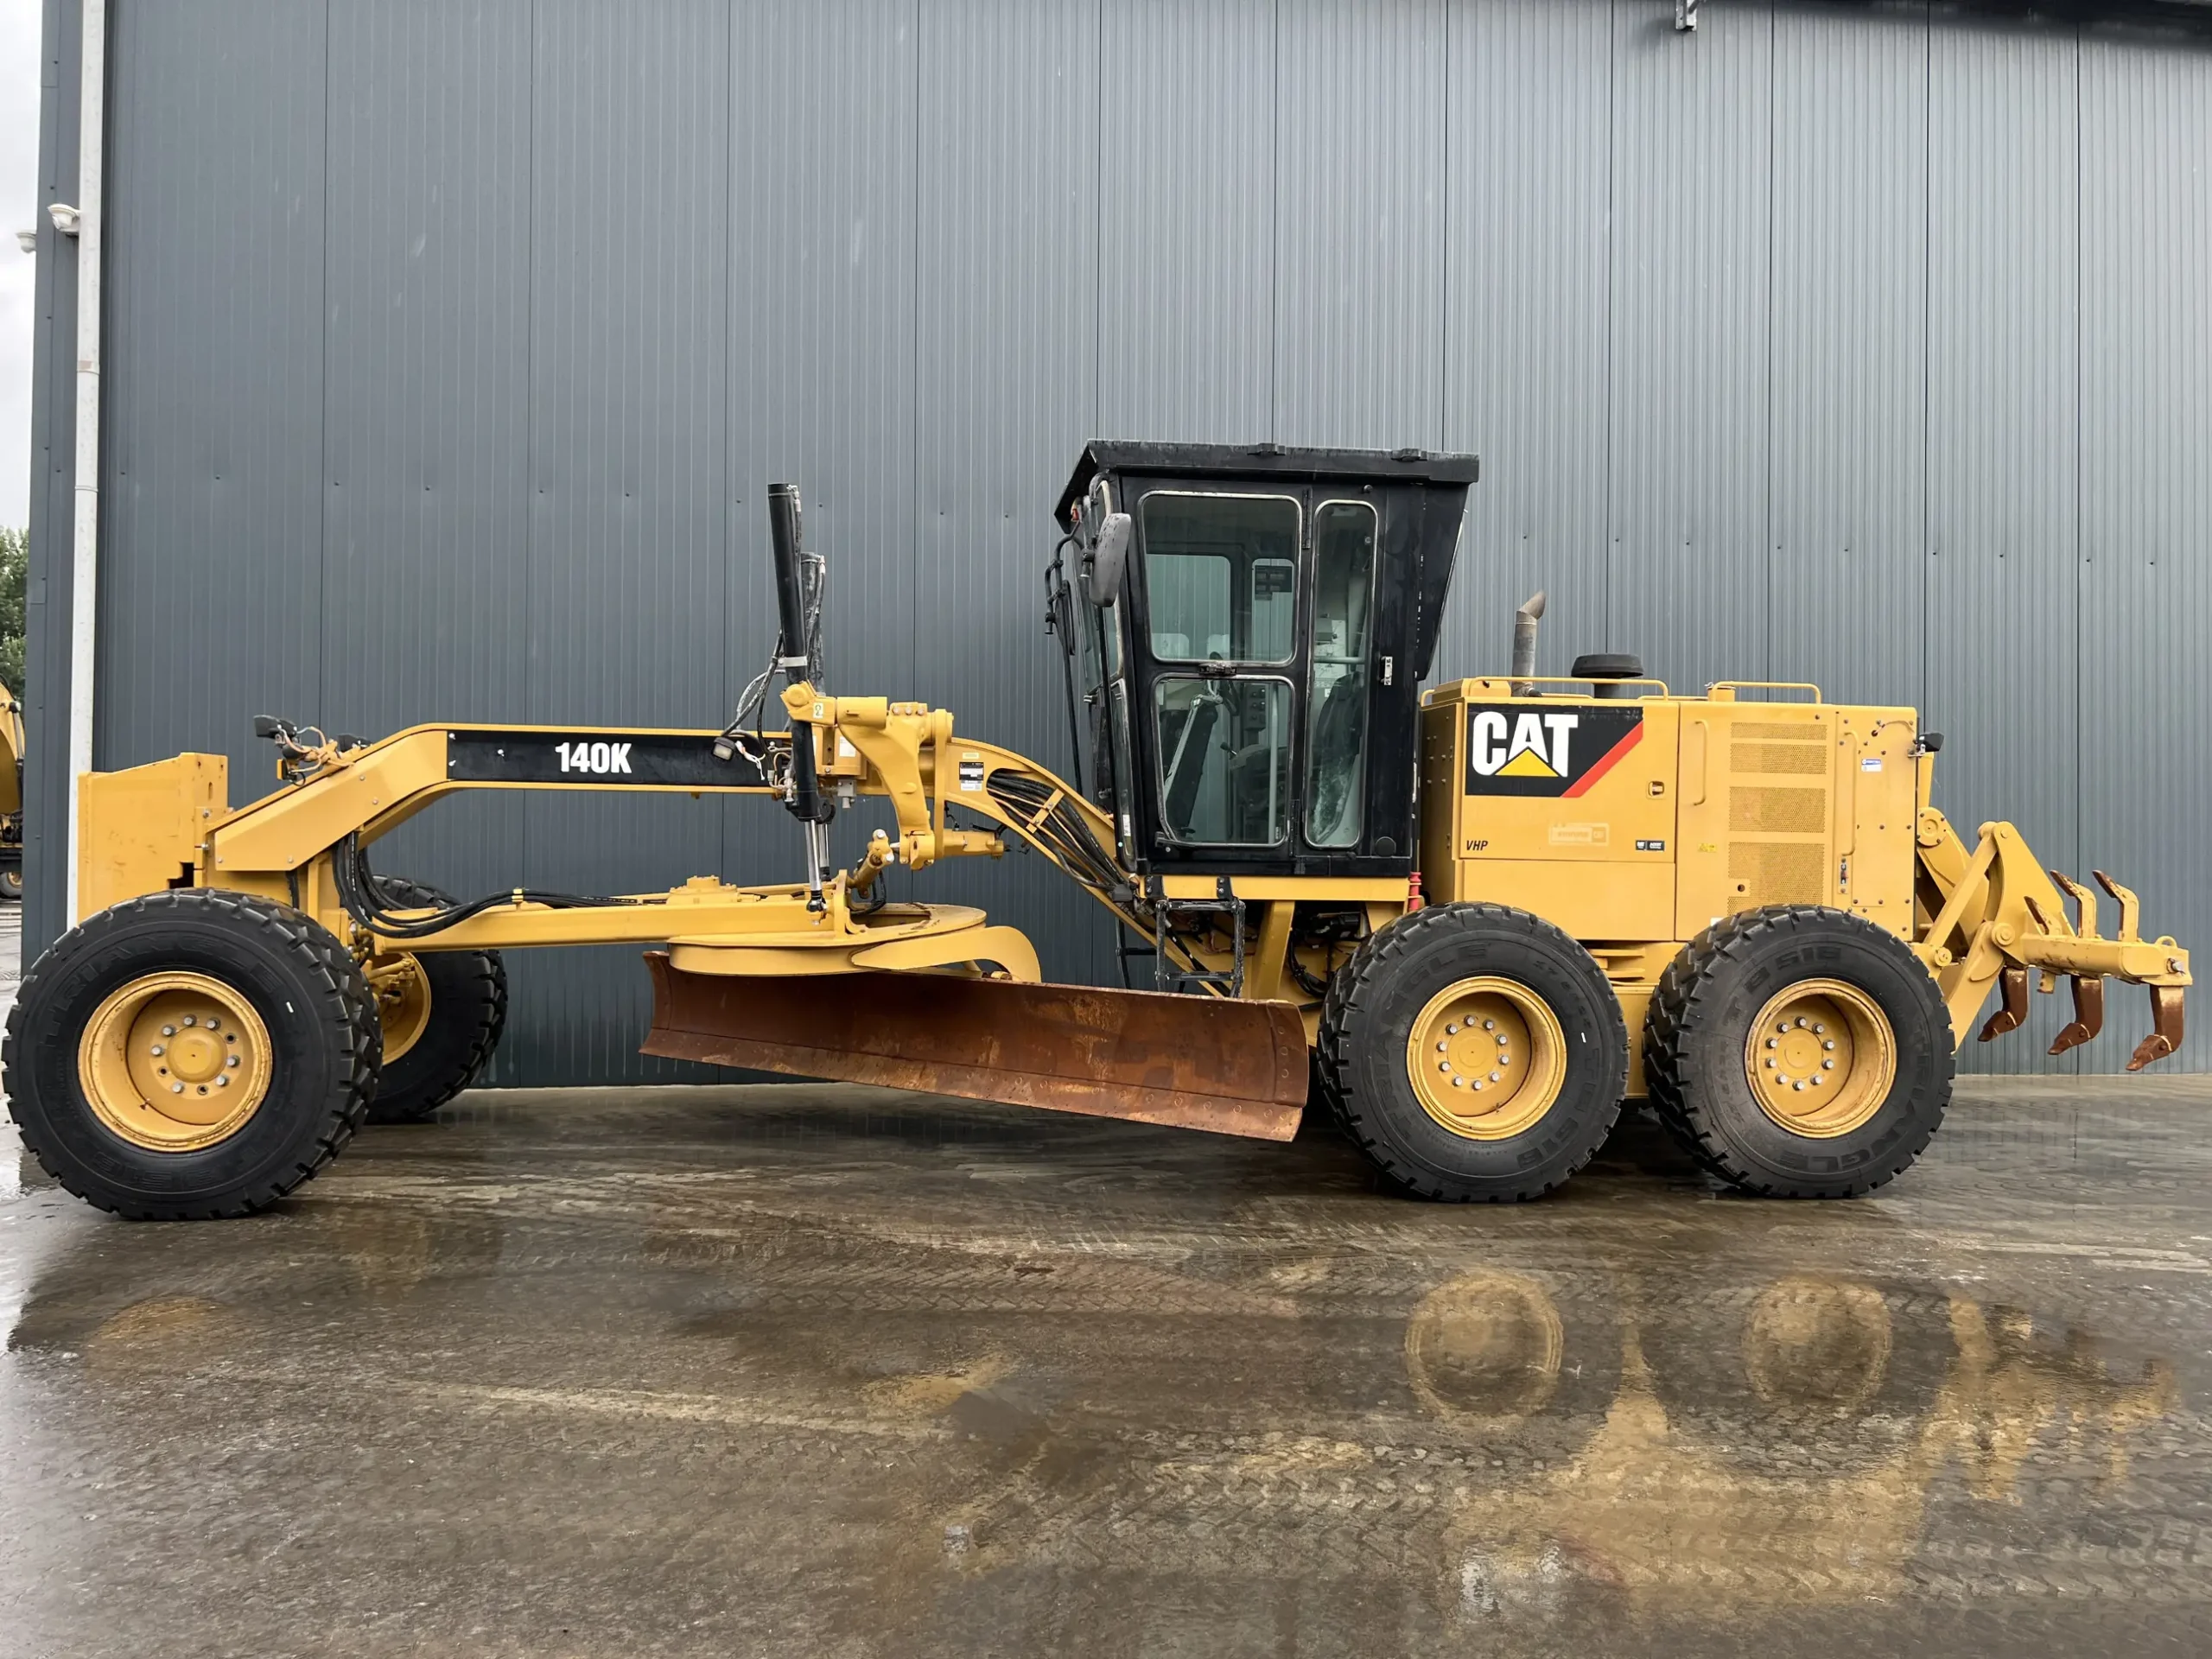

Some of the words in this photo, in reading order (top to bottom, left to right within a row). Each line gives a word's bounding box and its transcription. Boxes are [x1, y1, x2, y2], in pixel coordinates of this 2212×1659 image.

[555, 742, 632, 773] 140K
[1472, 711, 1579, 777] CAT
[1466, 840, 1489, 851] VHP
